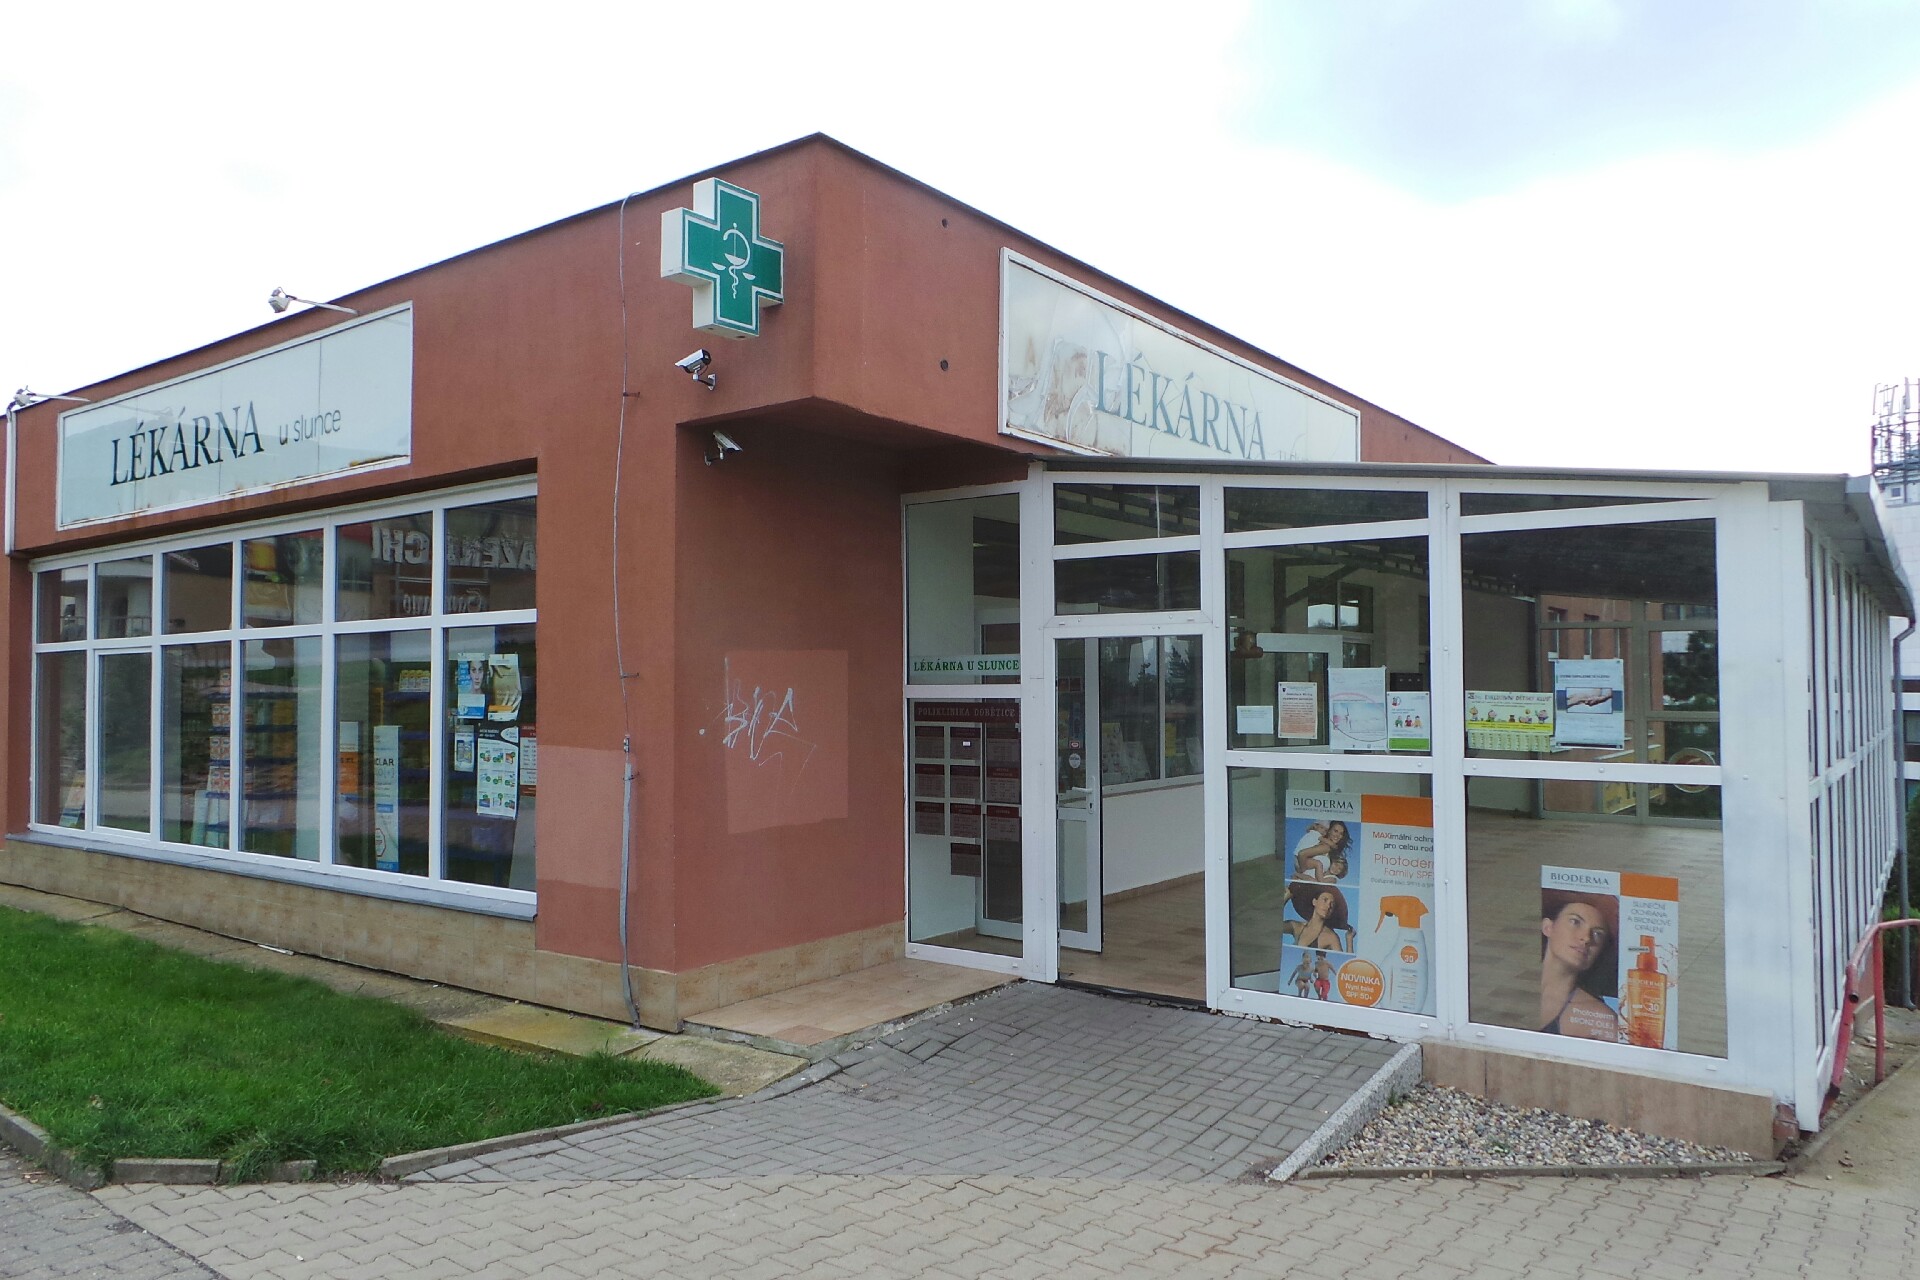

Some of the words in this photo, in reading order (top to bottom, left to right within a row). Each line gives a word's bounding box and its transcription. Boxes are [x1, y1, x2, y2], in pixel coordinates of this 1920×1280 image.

[1096, 350, 1266, 460] LÉKÁRNA
[110, 400, 265, 486] LÉKÁRNA
[279, 423, 288, 445] u
[293, 409, 341, 444] slunce
[914, 658, 963, 671] LÉKÁRNA
[967, 660, 974, 671] U
[978, 660, 1019, 671] SLUNCE
[917, 706, 970, 717] POLIKLINIKA
[974, 706, 1015, 717] DOBĚTICE
[1293, 797, 1353, 810] BIODERMA
[1372, 831, 1412, 841] MAXimální
[1399, 843, 1419, 851] celou
[1384, 867, 1414, 879] Family
[1550, 873, 1609, 886] BIODERMA
[1404, 955, 1414, 963] 30
[1341, 973, 1380, 985] NOVINKA
[1572, 1007, 1614, 1019] Photoderm
[1596, 1021, 1614, 1029] OLEJ
